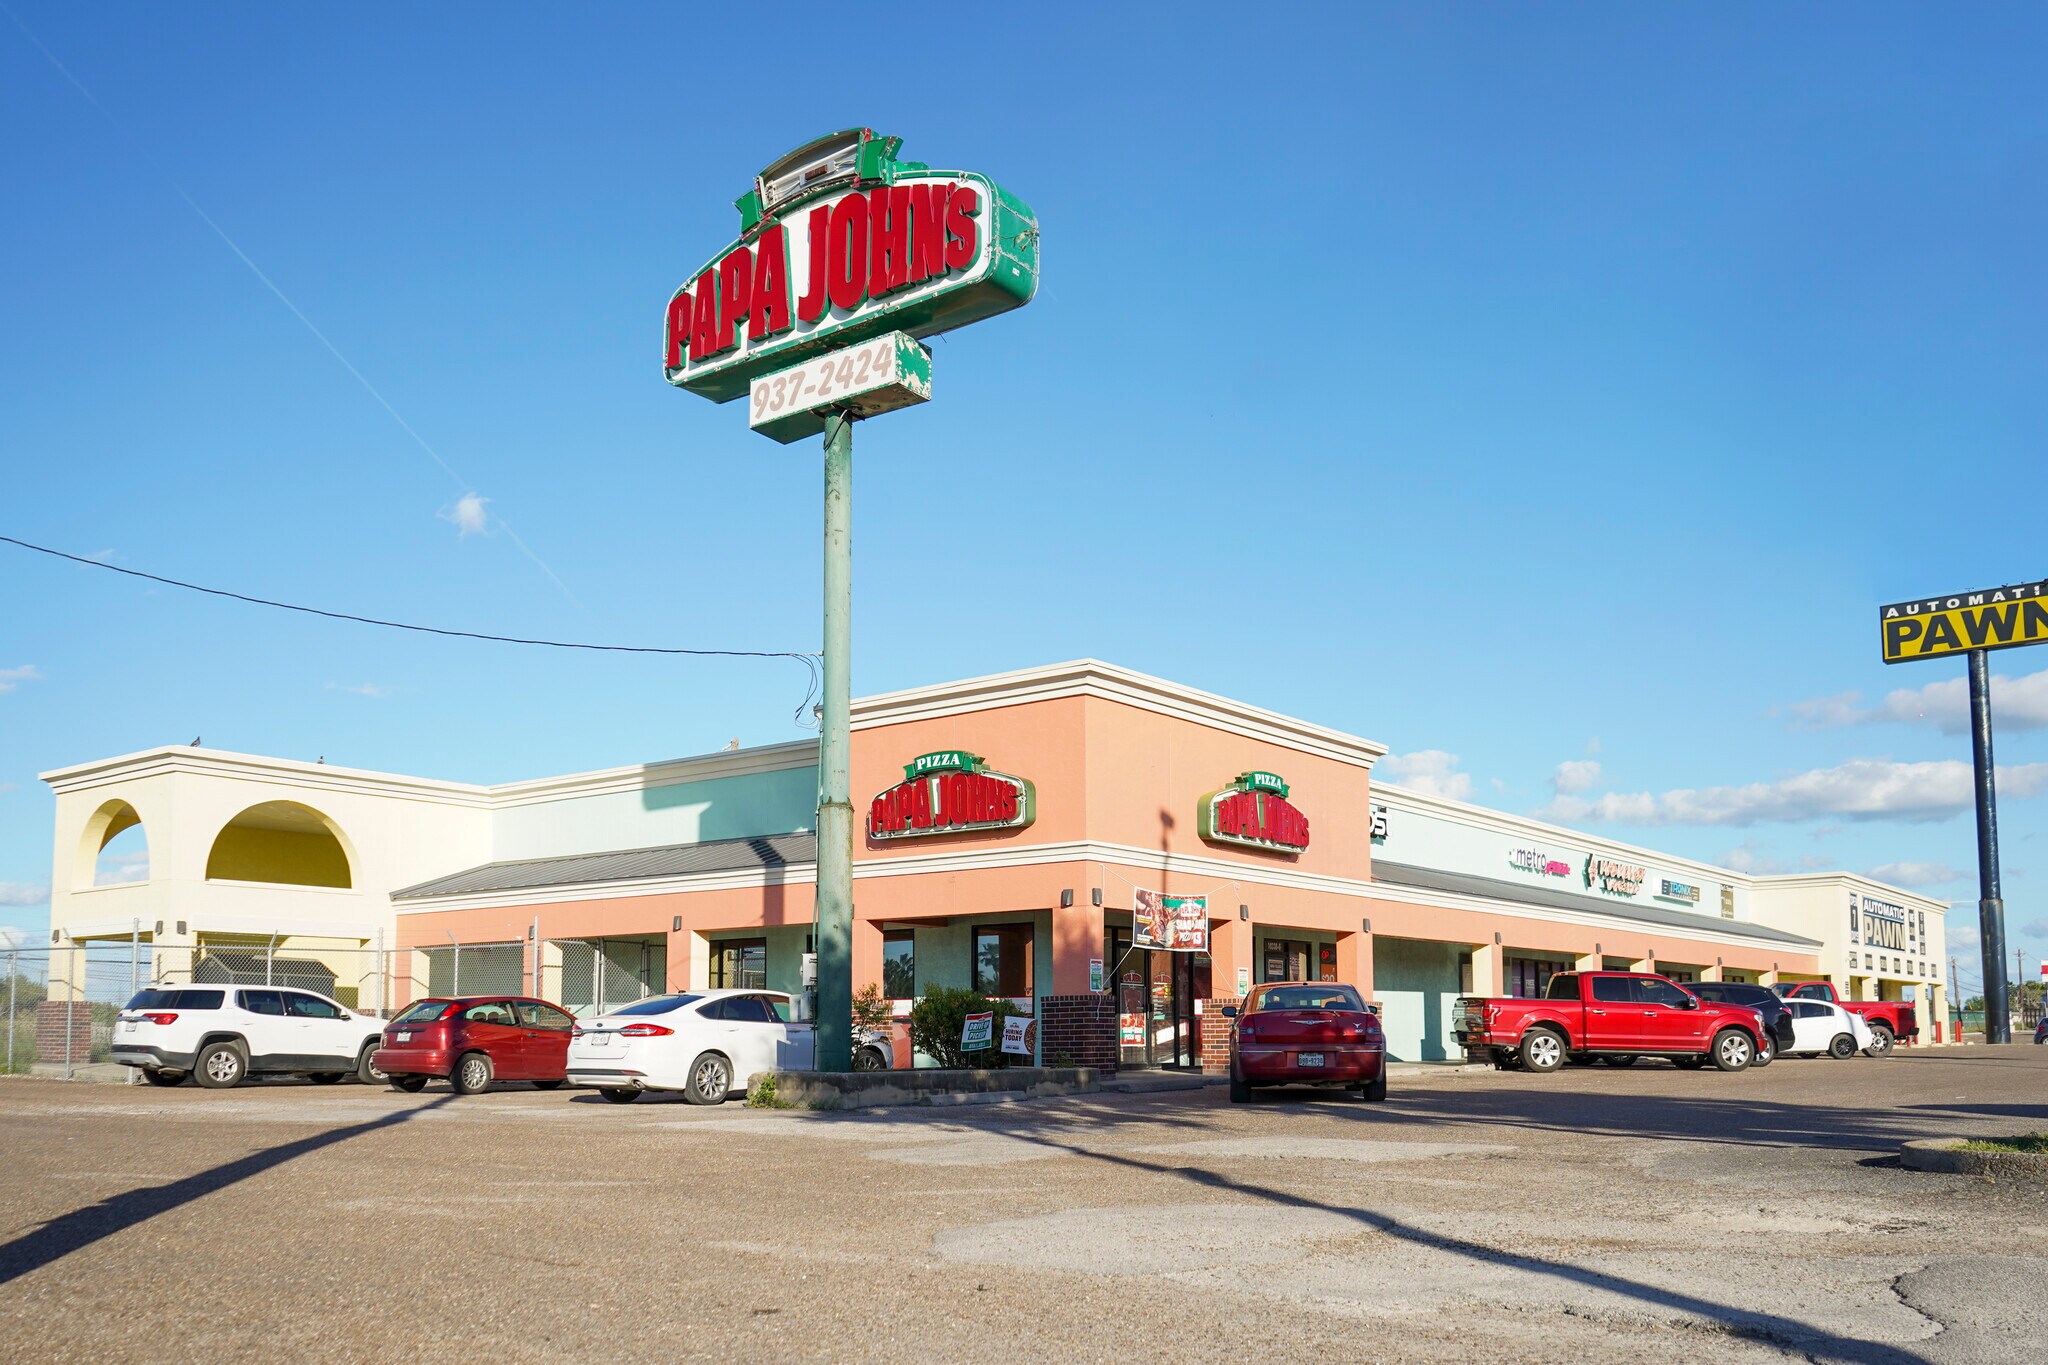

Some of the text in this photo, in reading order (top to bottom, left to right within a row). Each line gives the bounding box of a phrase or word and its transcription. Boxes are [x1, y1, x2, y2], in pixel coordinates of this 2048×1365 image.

[666, 224, 792, 369] PAPA
[753, 343, 893, 420] 937-2424
[916, 753, 960, 771] PIZZA
[1255, 773, 1282, 790] PIZZA
[871, 777, 932, 833] PAPA
[1218, 791, 1260, 838] PAPA
[1516, 848, 1547, 870] metro
[1863, 899, 1905, 920] AUTOMATIC
[1864, 915, 1906, 950] PAWN
